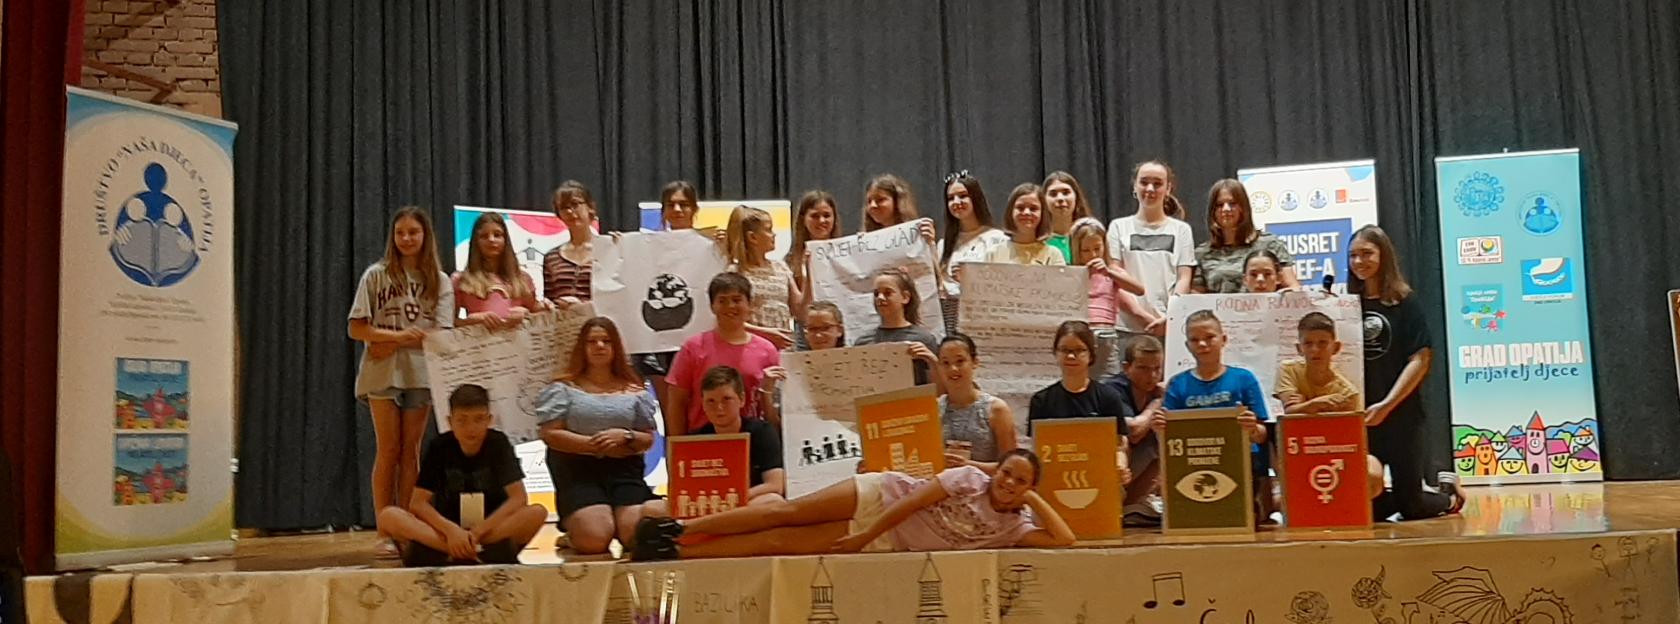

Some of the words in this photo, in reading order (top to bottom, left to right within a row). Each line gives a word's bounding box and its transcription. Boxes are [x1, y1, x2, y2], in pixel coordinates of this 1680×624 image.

[95, 158, 119, 235] DRUŠTVO
[199, 188, 214, 252] OPATIJA
[1294, 257, 1336, 281] EF-A
[1459, 344, 1506, 368] GRAD
[1508, 341, 1583, 367] OPATIJA
[1465, 363, 1530, 384] prijatelj
[1534, 363, 1579, 381] djece
[1185, 391, 1231, 407] GAMER
[865, 422, 880, 440] 11
[1041, 444, 1052, 463] 2
[1167, 438, 1184, 456] 13
[1287, 436, 1299, 454] 5
[678, 460, 685, 478] 1
